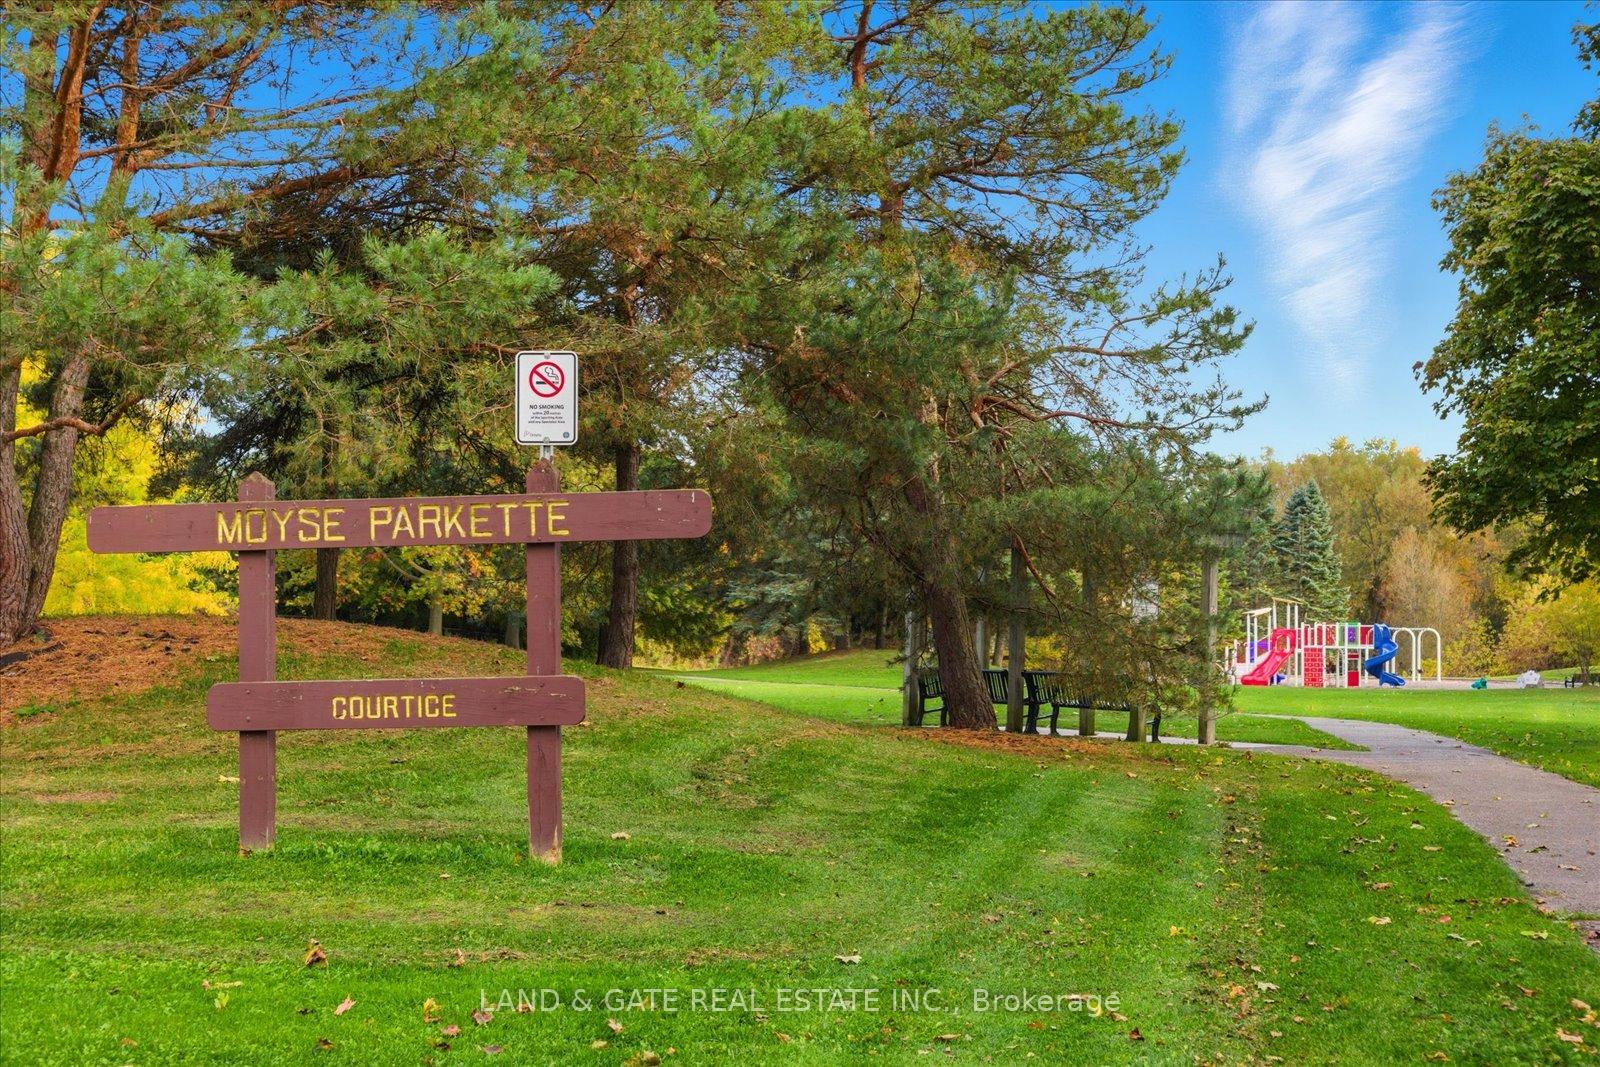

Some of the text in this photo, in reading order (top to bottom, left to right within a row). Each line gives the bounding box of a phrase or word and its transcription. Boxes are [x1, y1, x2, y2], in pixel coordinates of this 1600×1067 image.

[217, 500, 570, 544] MOYSE PARKETTE
[332, 694, 457, 720] COURTICE
